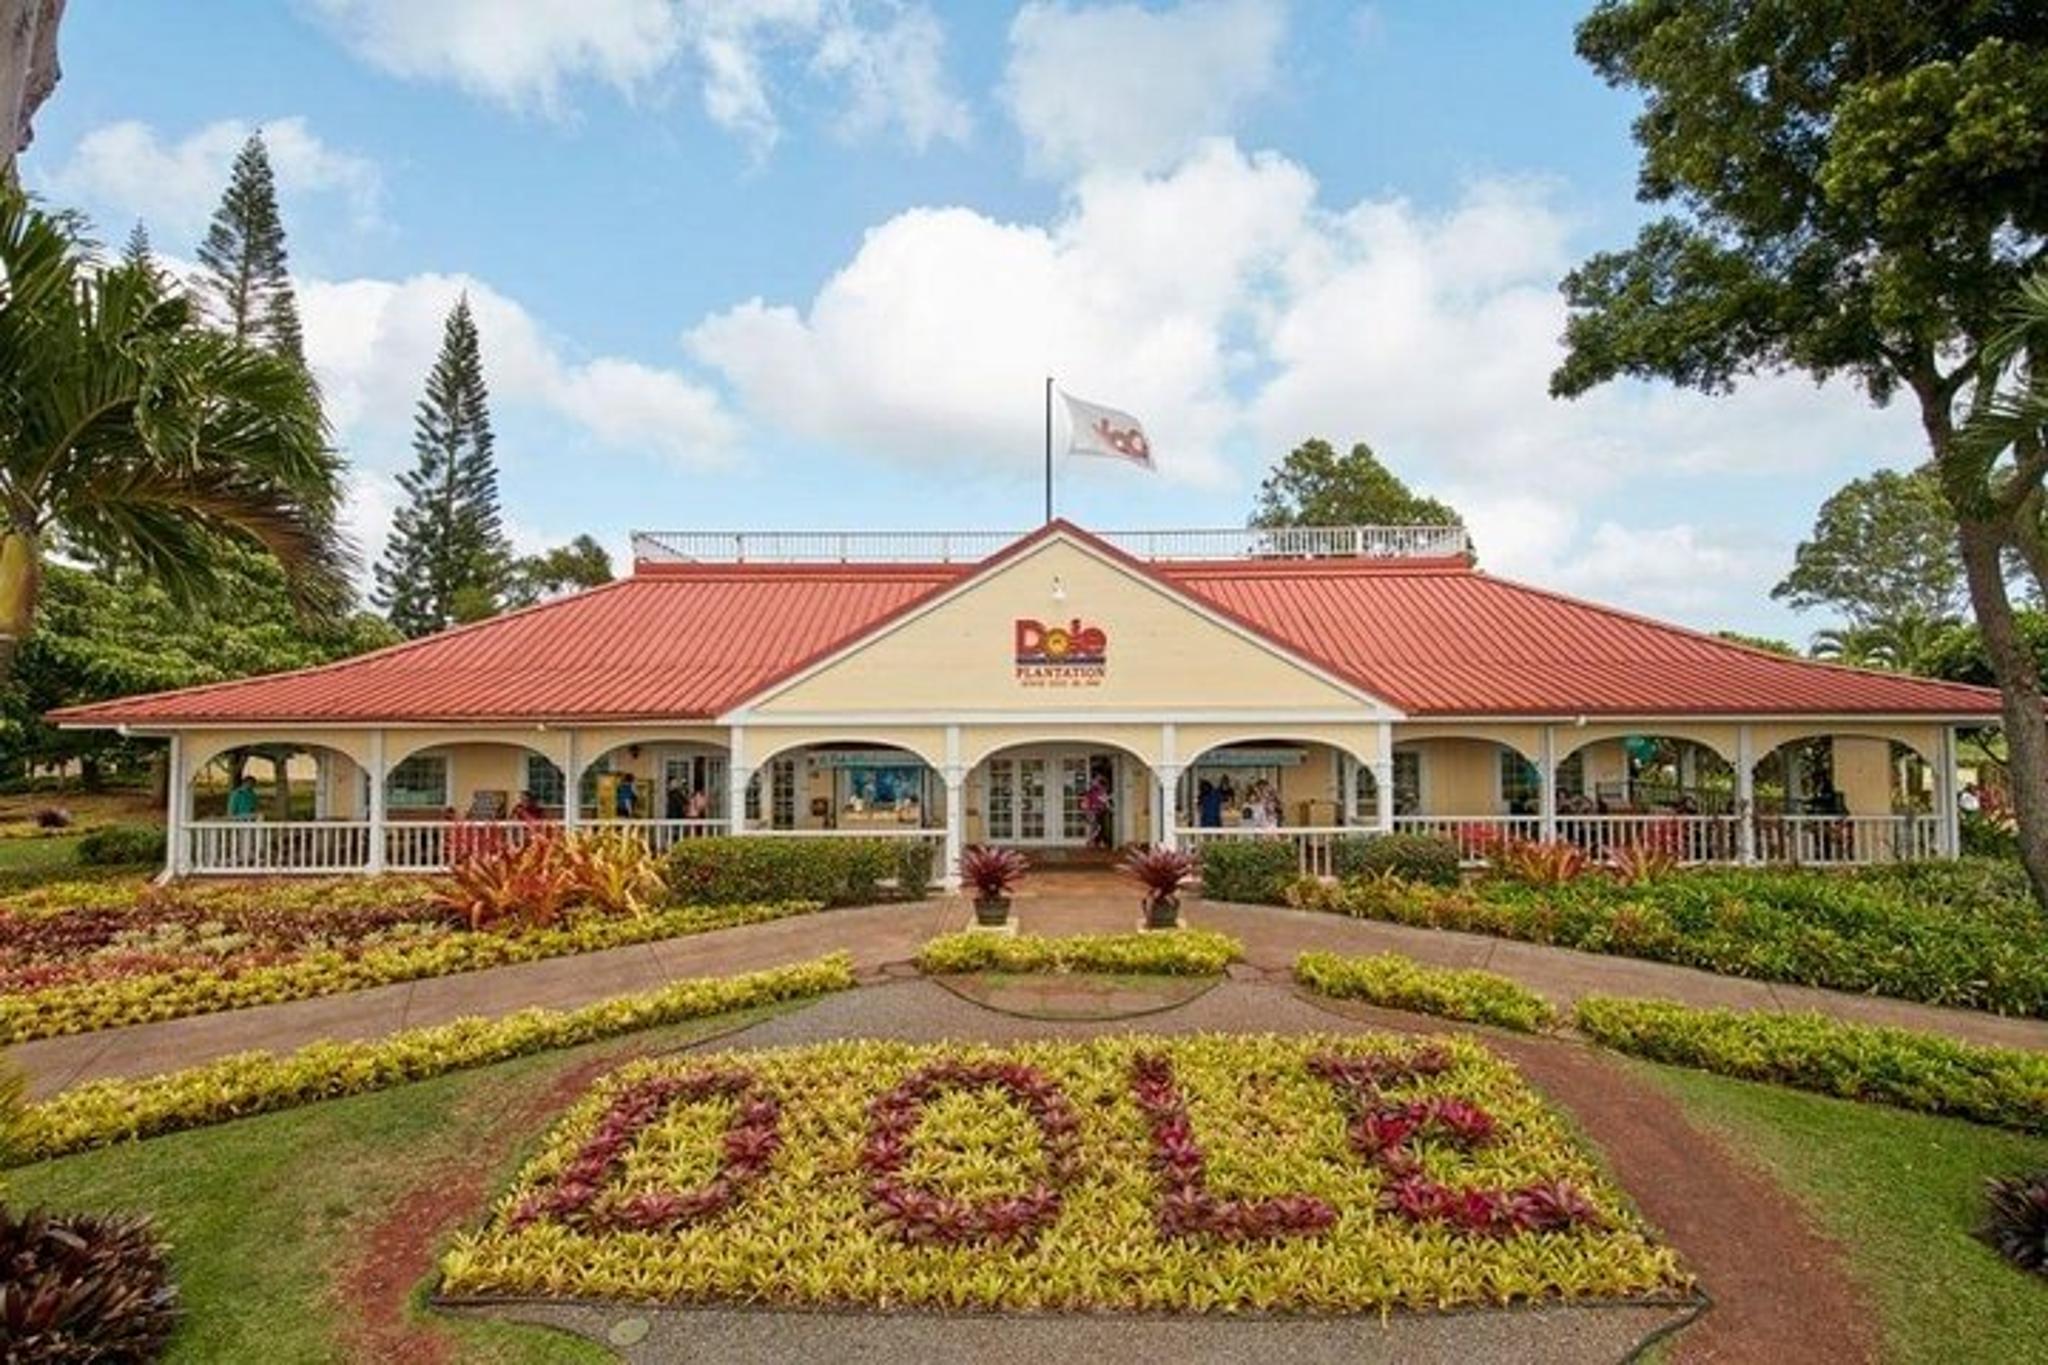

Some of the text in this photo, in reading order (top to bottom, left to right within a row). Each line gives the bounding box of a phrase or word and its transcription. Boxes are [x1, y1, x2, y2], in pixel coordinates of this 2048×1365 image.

[1016, 618, 1107, 657] Dole
[1016, 667, 1105, 678] PLANTATION
[510, 1051, 1602, 1246] DOLE
